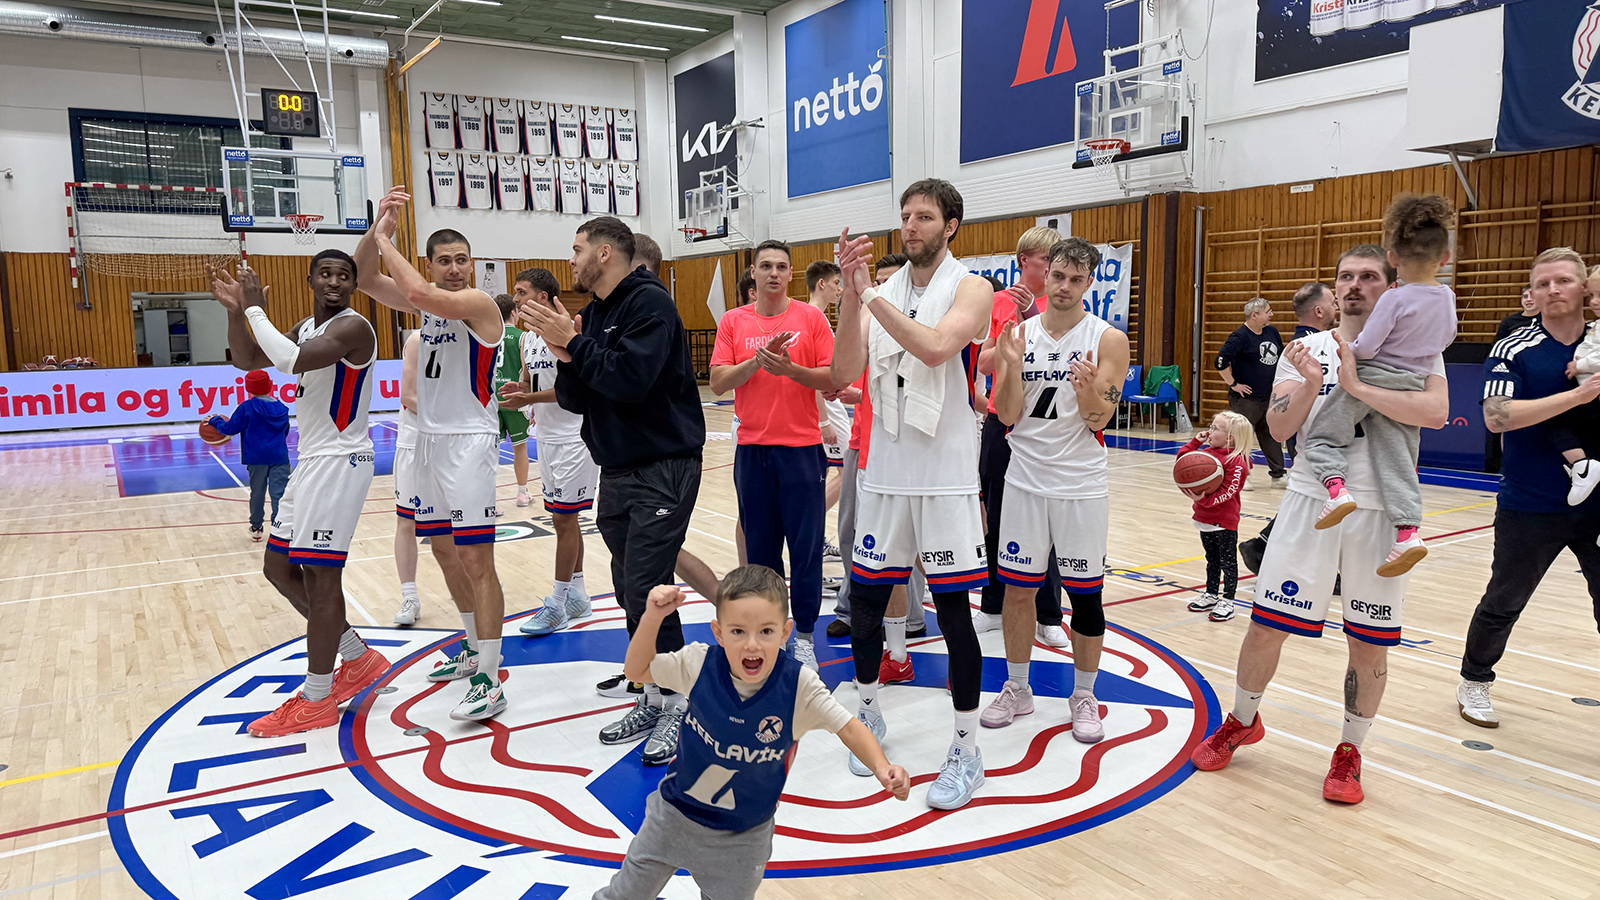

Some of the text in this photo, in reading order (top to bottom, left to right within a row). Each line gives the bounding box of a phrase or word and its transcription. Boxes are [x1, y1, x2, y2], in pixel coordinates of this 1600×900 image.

[1567, 87, 1600, 116] KE
[434, 121, 449, 129] 1988
[499, 126, 514, 134] 1990
[563, 130, 577, 139] 1994
[117, 388, 170, 418] og
[1264, 589, 1313, 610] Kristall
[1350, 599, 1392, 616] GEYSIR
[685, 712, 785, 764] KEFLAVÍK
